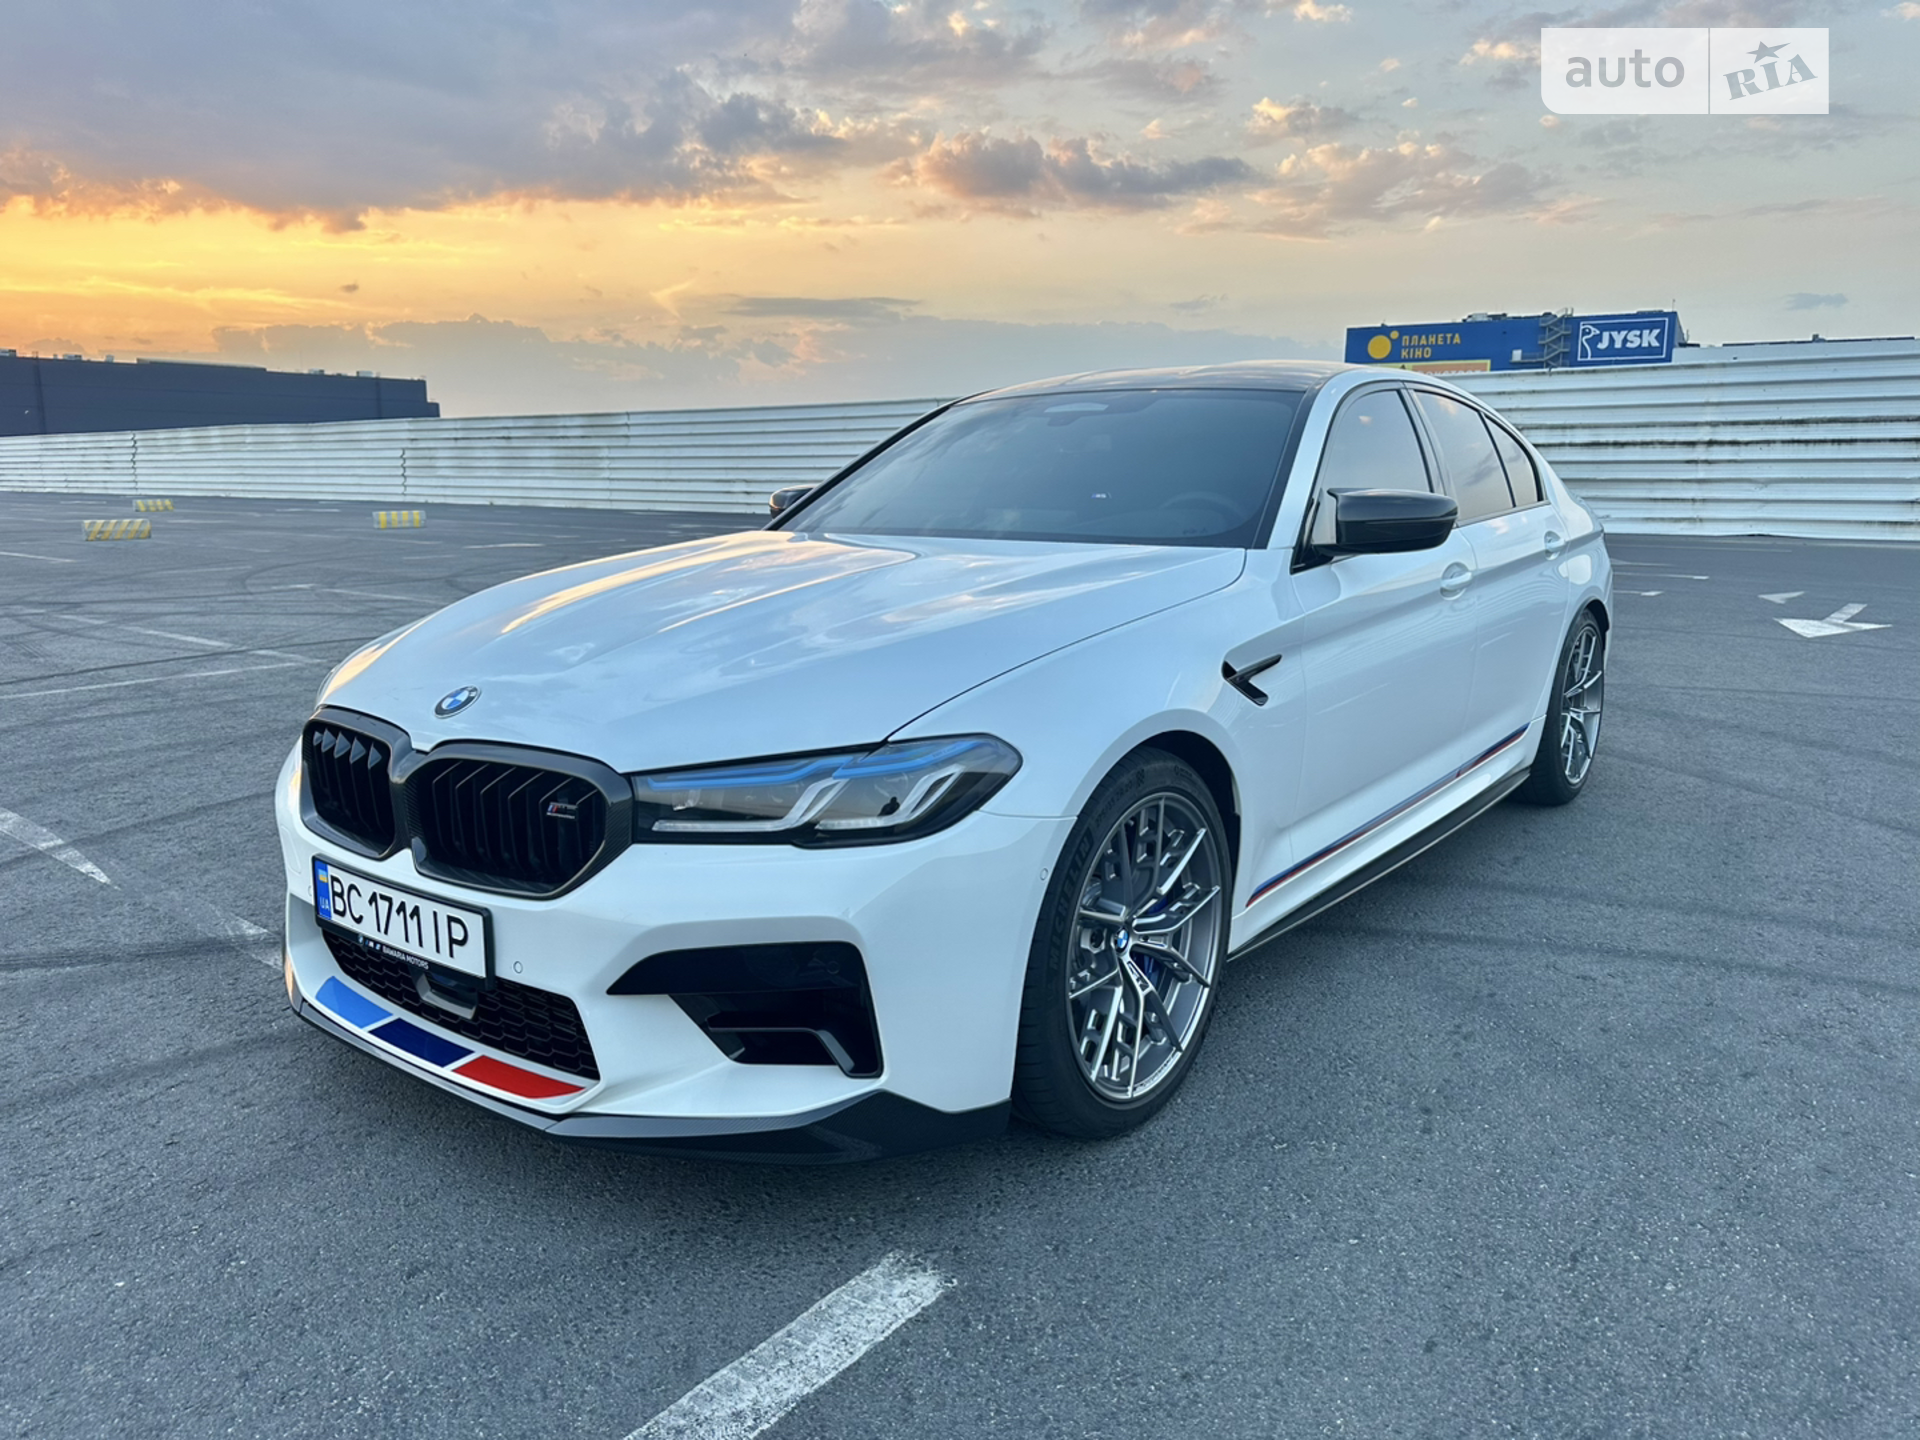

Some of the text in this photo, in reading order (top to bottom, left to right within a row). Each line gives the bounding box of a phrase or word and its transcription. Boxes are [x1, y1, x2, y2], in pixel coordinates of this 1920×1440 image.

[1401, 333, 1461, 347] ПЛАНЕТА
[1596, 329, 1660, 350] JYSK
[1401, 347, 1432, 359] КІНО
[1049, 836, 1091, 970] MICHELIN
[331, 875, 469, 958] BC 1711 IP
